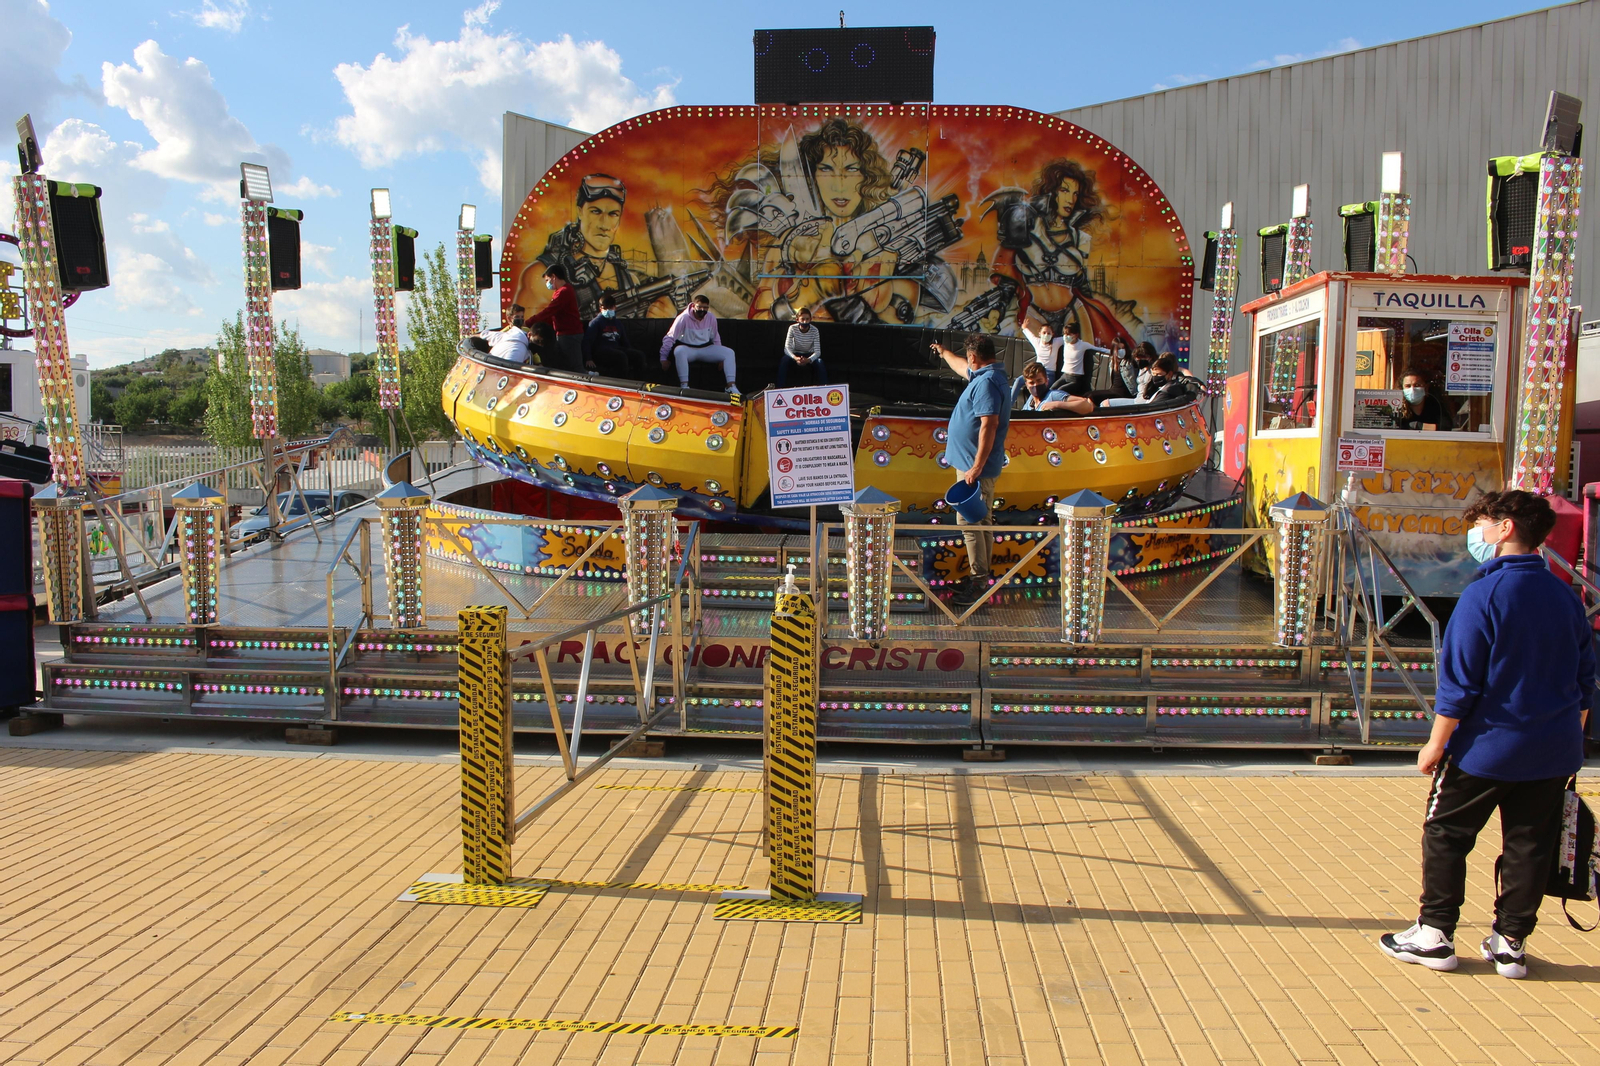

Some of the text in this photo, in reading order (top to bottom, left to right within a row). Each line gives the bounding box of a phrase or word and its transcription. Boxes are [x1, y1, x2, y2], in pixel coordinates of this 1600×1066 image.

[1373, 292, 1486, 310] TAQUILLA
[792, 394, 822, 406] Olla
[785, 406, 831, 419] Cristo
[1362, 464, 1476, 500] Crazy
[820, 646, 964, 672] CRISTO
[792, 694, 798, 702] DE
[473, 717, 478, 726] DE
[776, 711, 782, 720] DE
